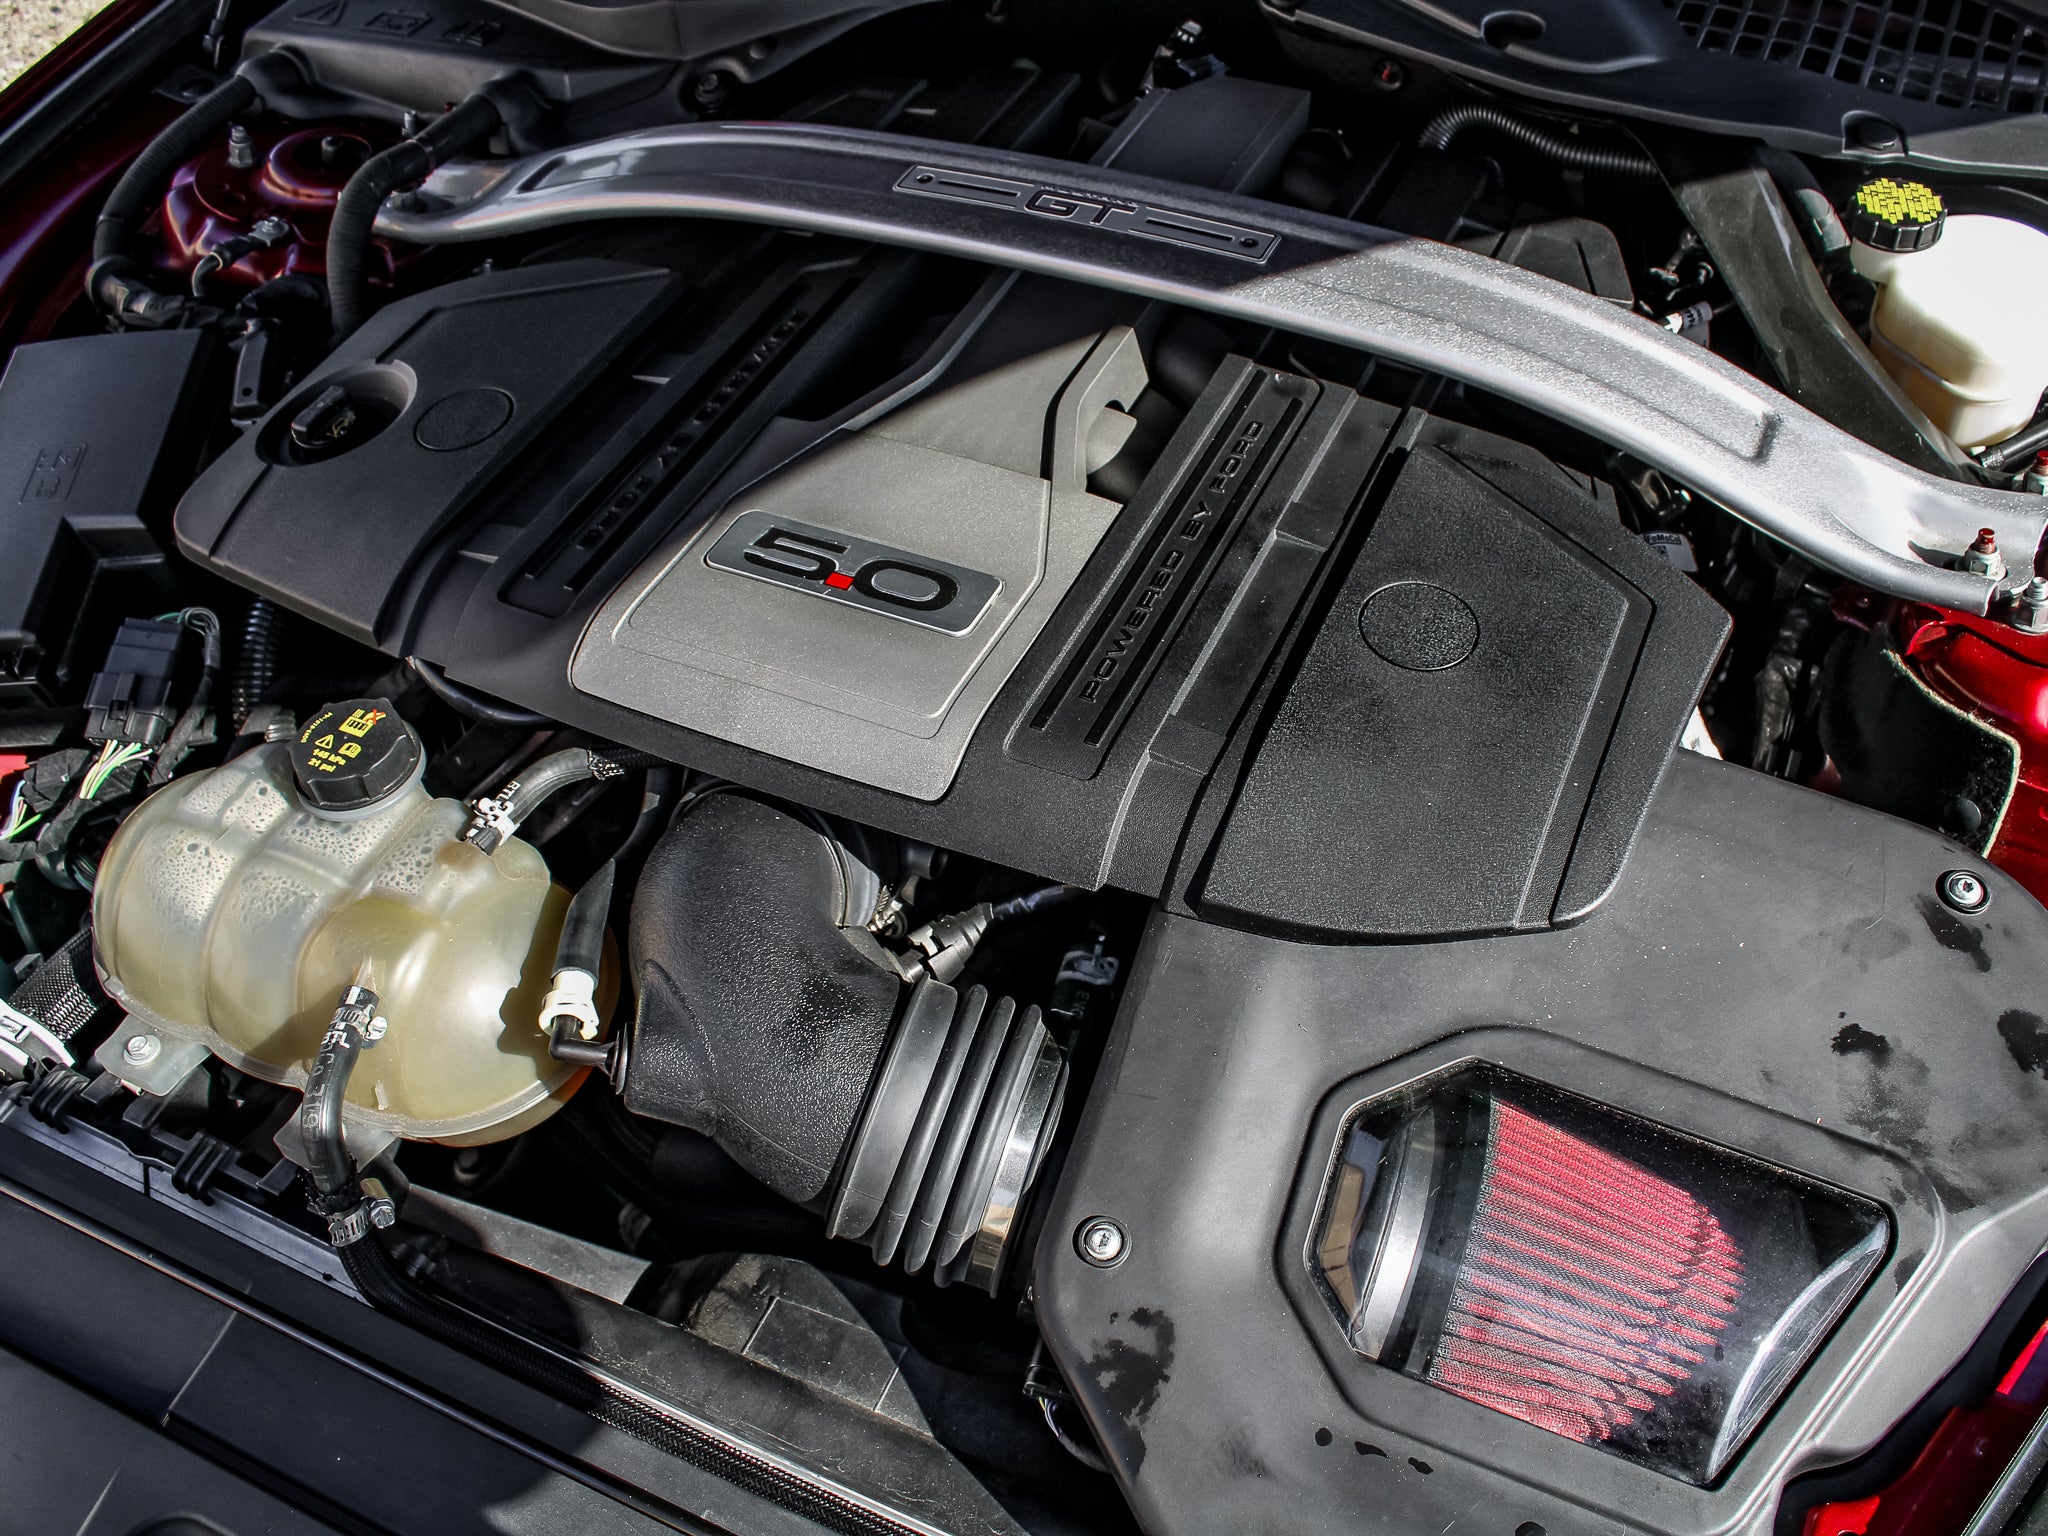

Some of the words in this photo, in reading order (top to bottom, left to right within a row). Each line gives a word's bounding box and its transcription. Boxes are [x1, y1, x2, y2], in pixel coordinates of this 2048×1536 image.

[1024, 190, 1139, 225] GT
[743, 526, 961, 612] 5.0
[1079, 549, 1186, 704] POWERED
[1180, 500, 1213, 541] BY
[1209, 420, 1264, 494] FORD
[307, 757, 322, 768] 21
[318, 763, 337, 773] psi
[312, 748, 331, 760] 145
[328, 753, 347, 766] kPa
